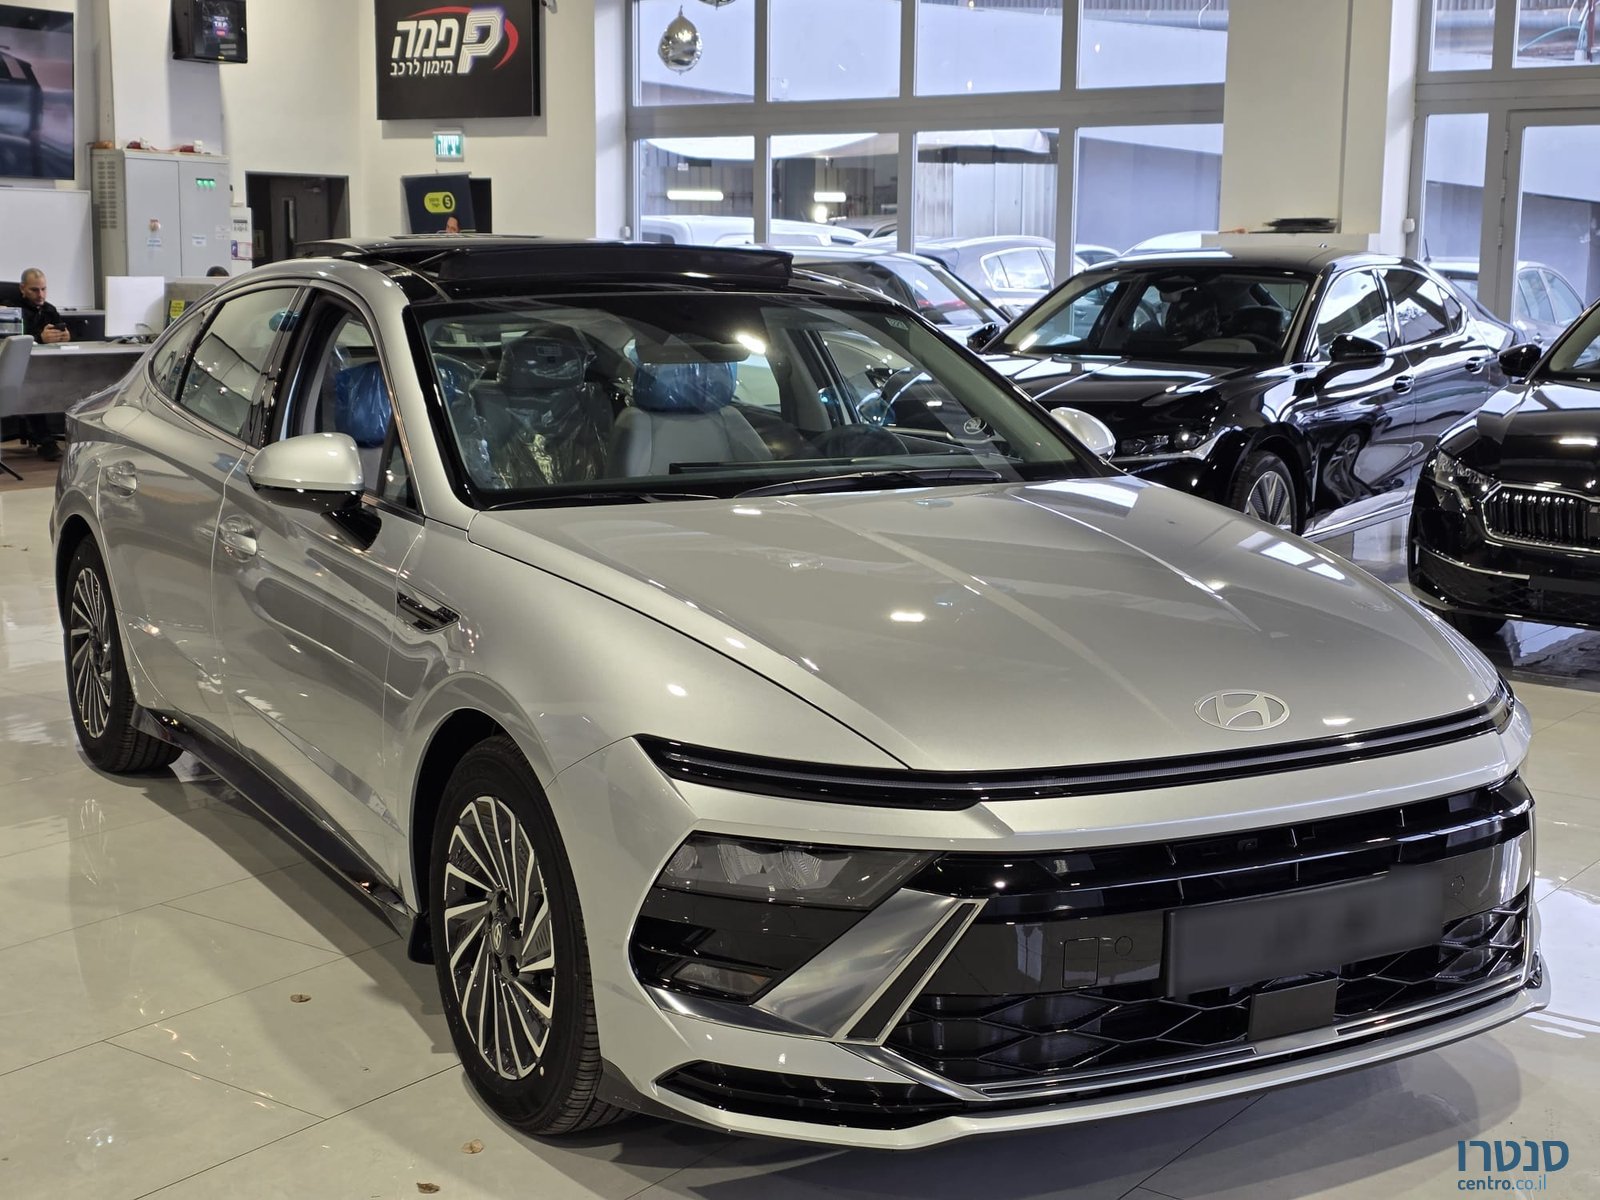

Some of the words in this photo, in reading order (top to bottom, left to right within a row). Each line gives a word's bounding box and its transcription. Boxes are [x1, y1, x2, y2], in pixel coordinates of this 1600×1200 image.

[391, 18, 460, 59] פמה
[390, 59, 420, 76] לרכב
[421, 60, 453, 77] מימון
